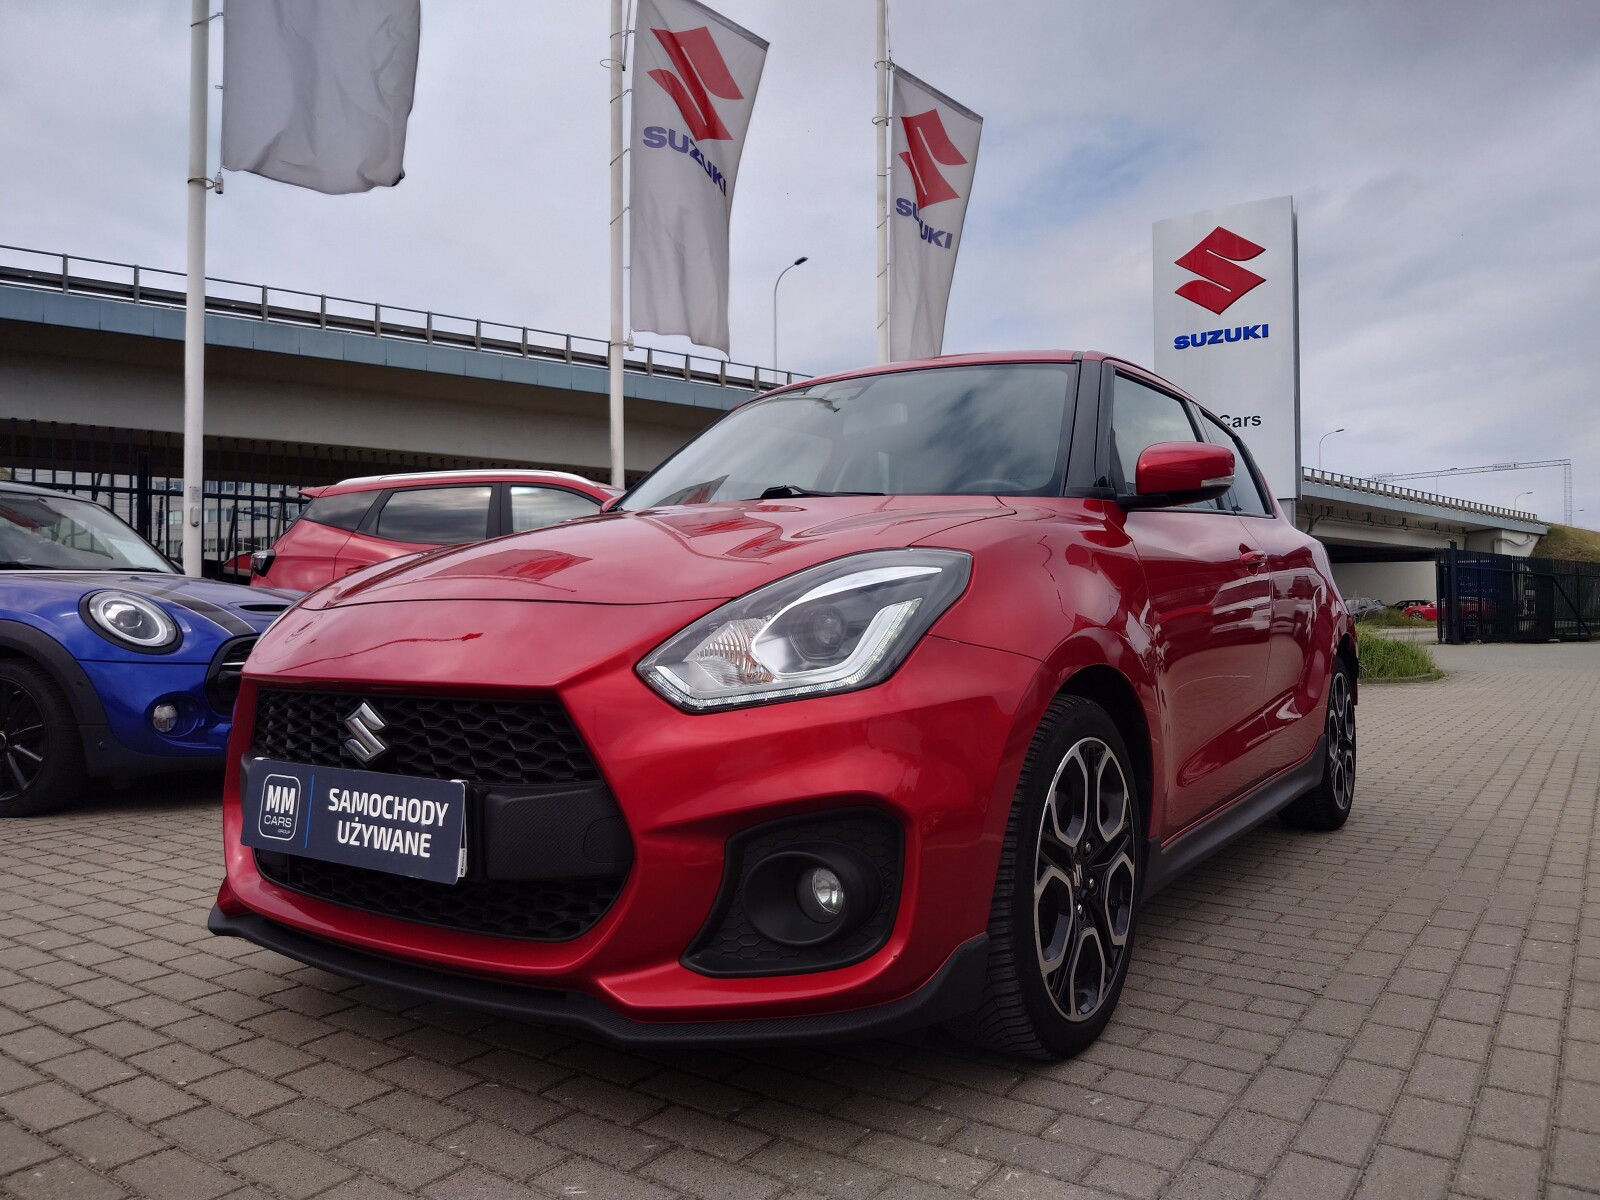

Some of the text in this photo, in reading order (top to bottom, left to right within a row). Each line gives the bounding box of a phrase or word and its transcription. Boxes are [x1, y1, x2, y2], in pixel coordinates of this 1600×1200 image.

[643, 126, 726, 197] SUZUKI
[896, 197, 953, 249] SUUKI
[1174, 323, 1269, 350] SUZUKI
[266, 784, 296, 815] MM
[328, 788, 449, 827] SAMOCHODY
[263, 814, 293, 828] CARS
[337, 816, 432, 858] UŻYWANE
